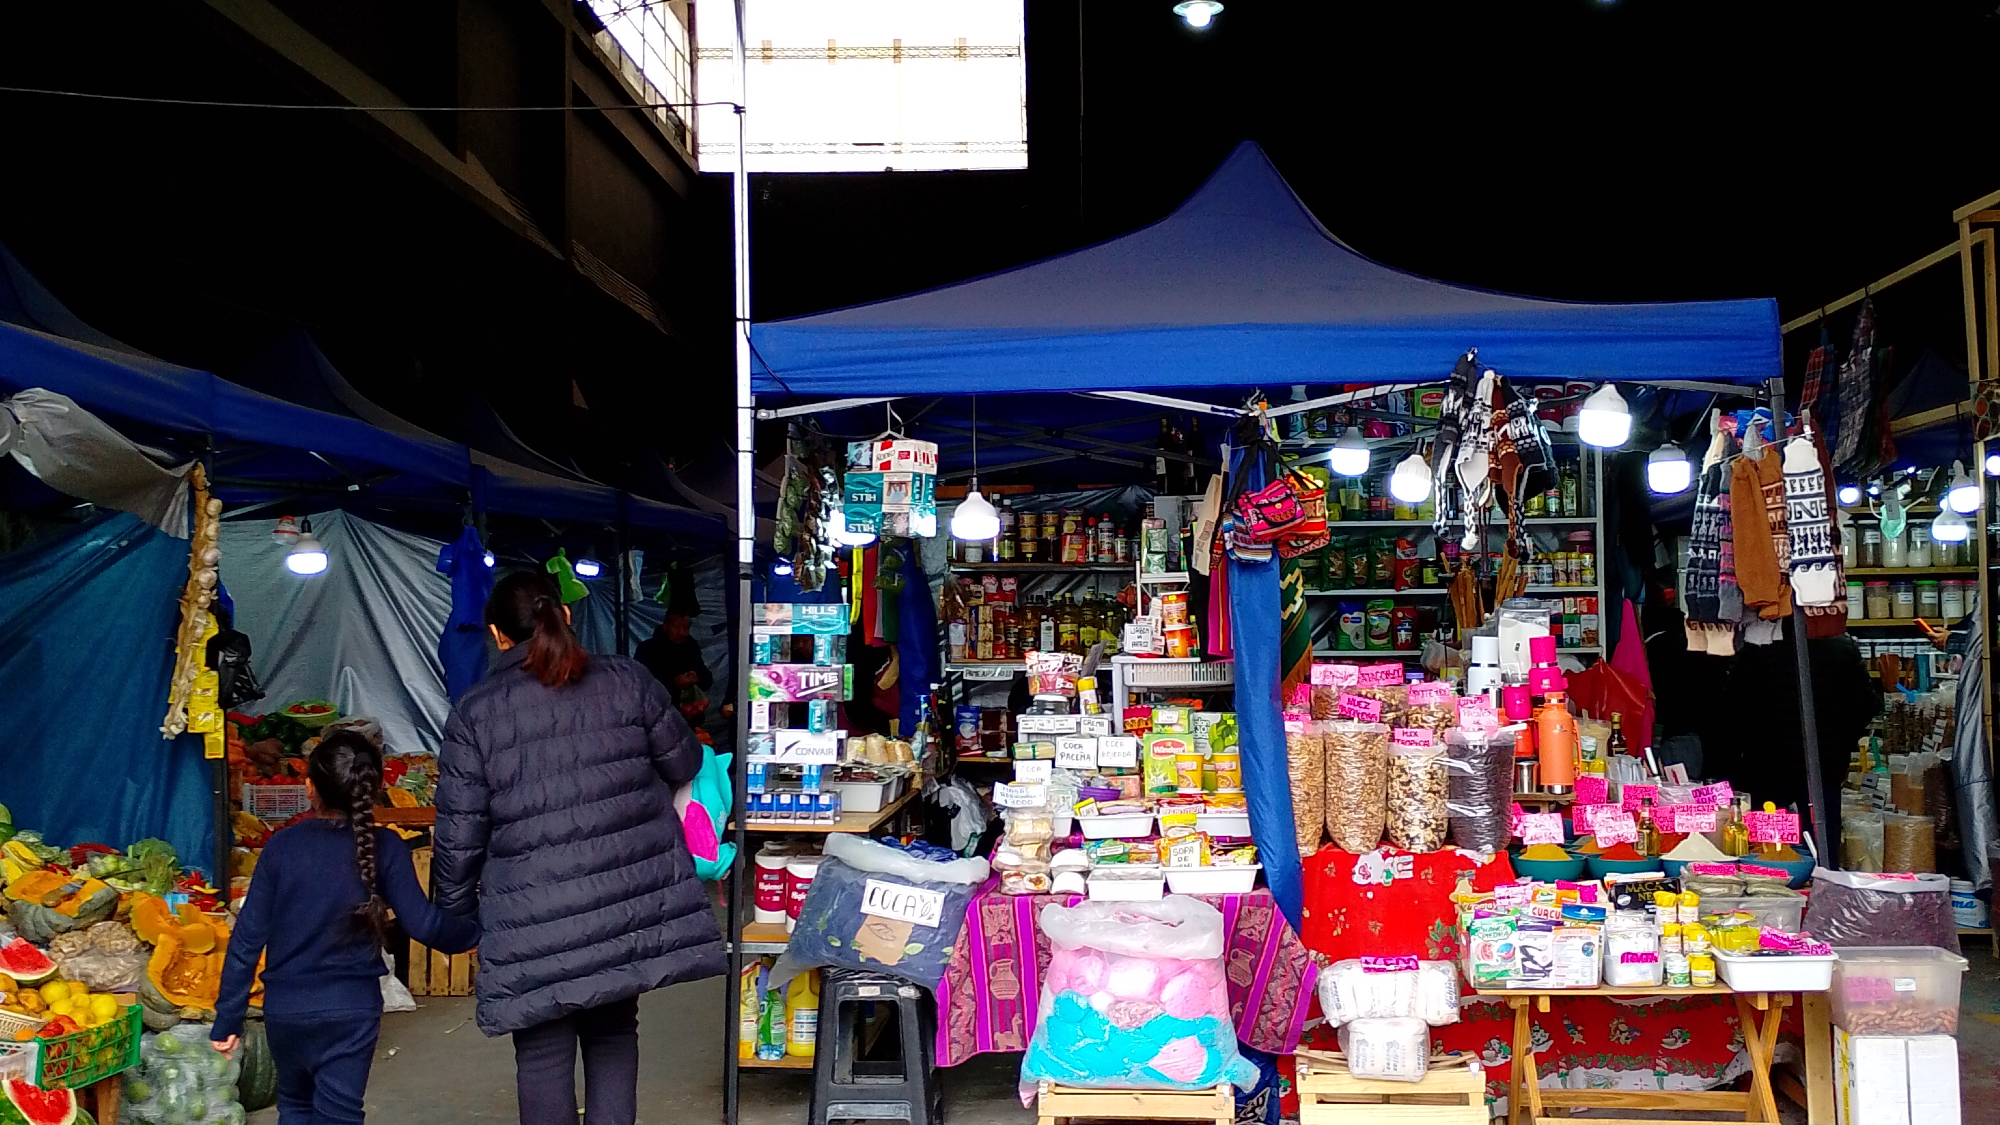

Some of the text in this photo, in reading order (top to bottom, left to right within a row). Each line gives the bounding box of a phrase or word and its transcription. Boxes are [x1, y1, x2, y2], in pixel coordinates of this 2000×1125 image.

[802, 606, 838, 615] HILLS
[796, 671, 839, 689] TIME
[1063, 742, 1083, 750] COCA
[795, 747, 834, 757] CONVAIR
[1172, 847, 1194, 856] SOPA
[1625, 881, 1664, 893] MACA
[868, 886, 916, 918] COCA
[1638, 893, 1655, 902] NE
[1531, 907, 1561, 919] CURCU
